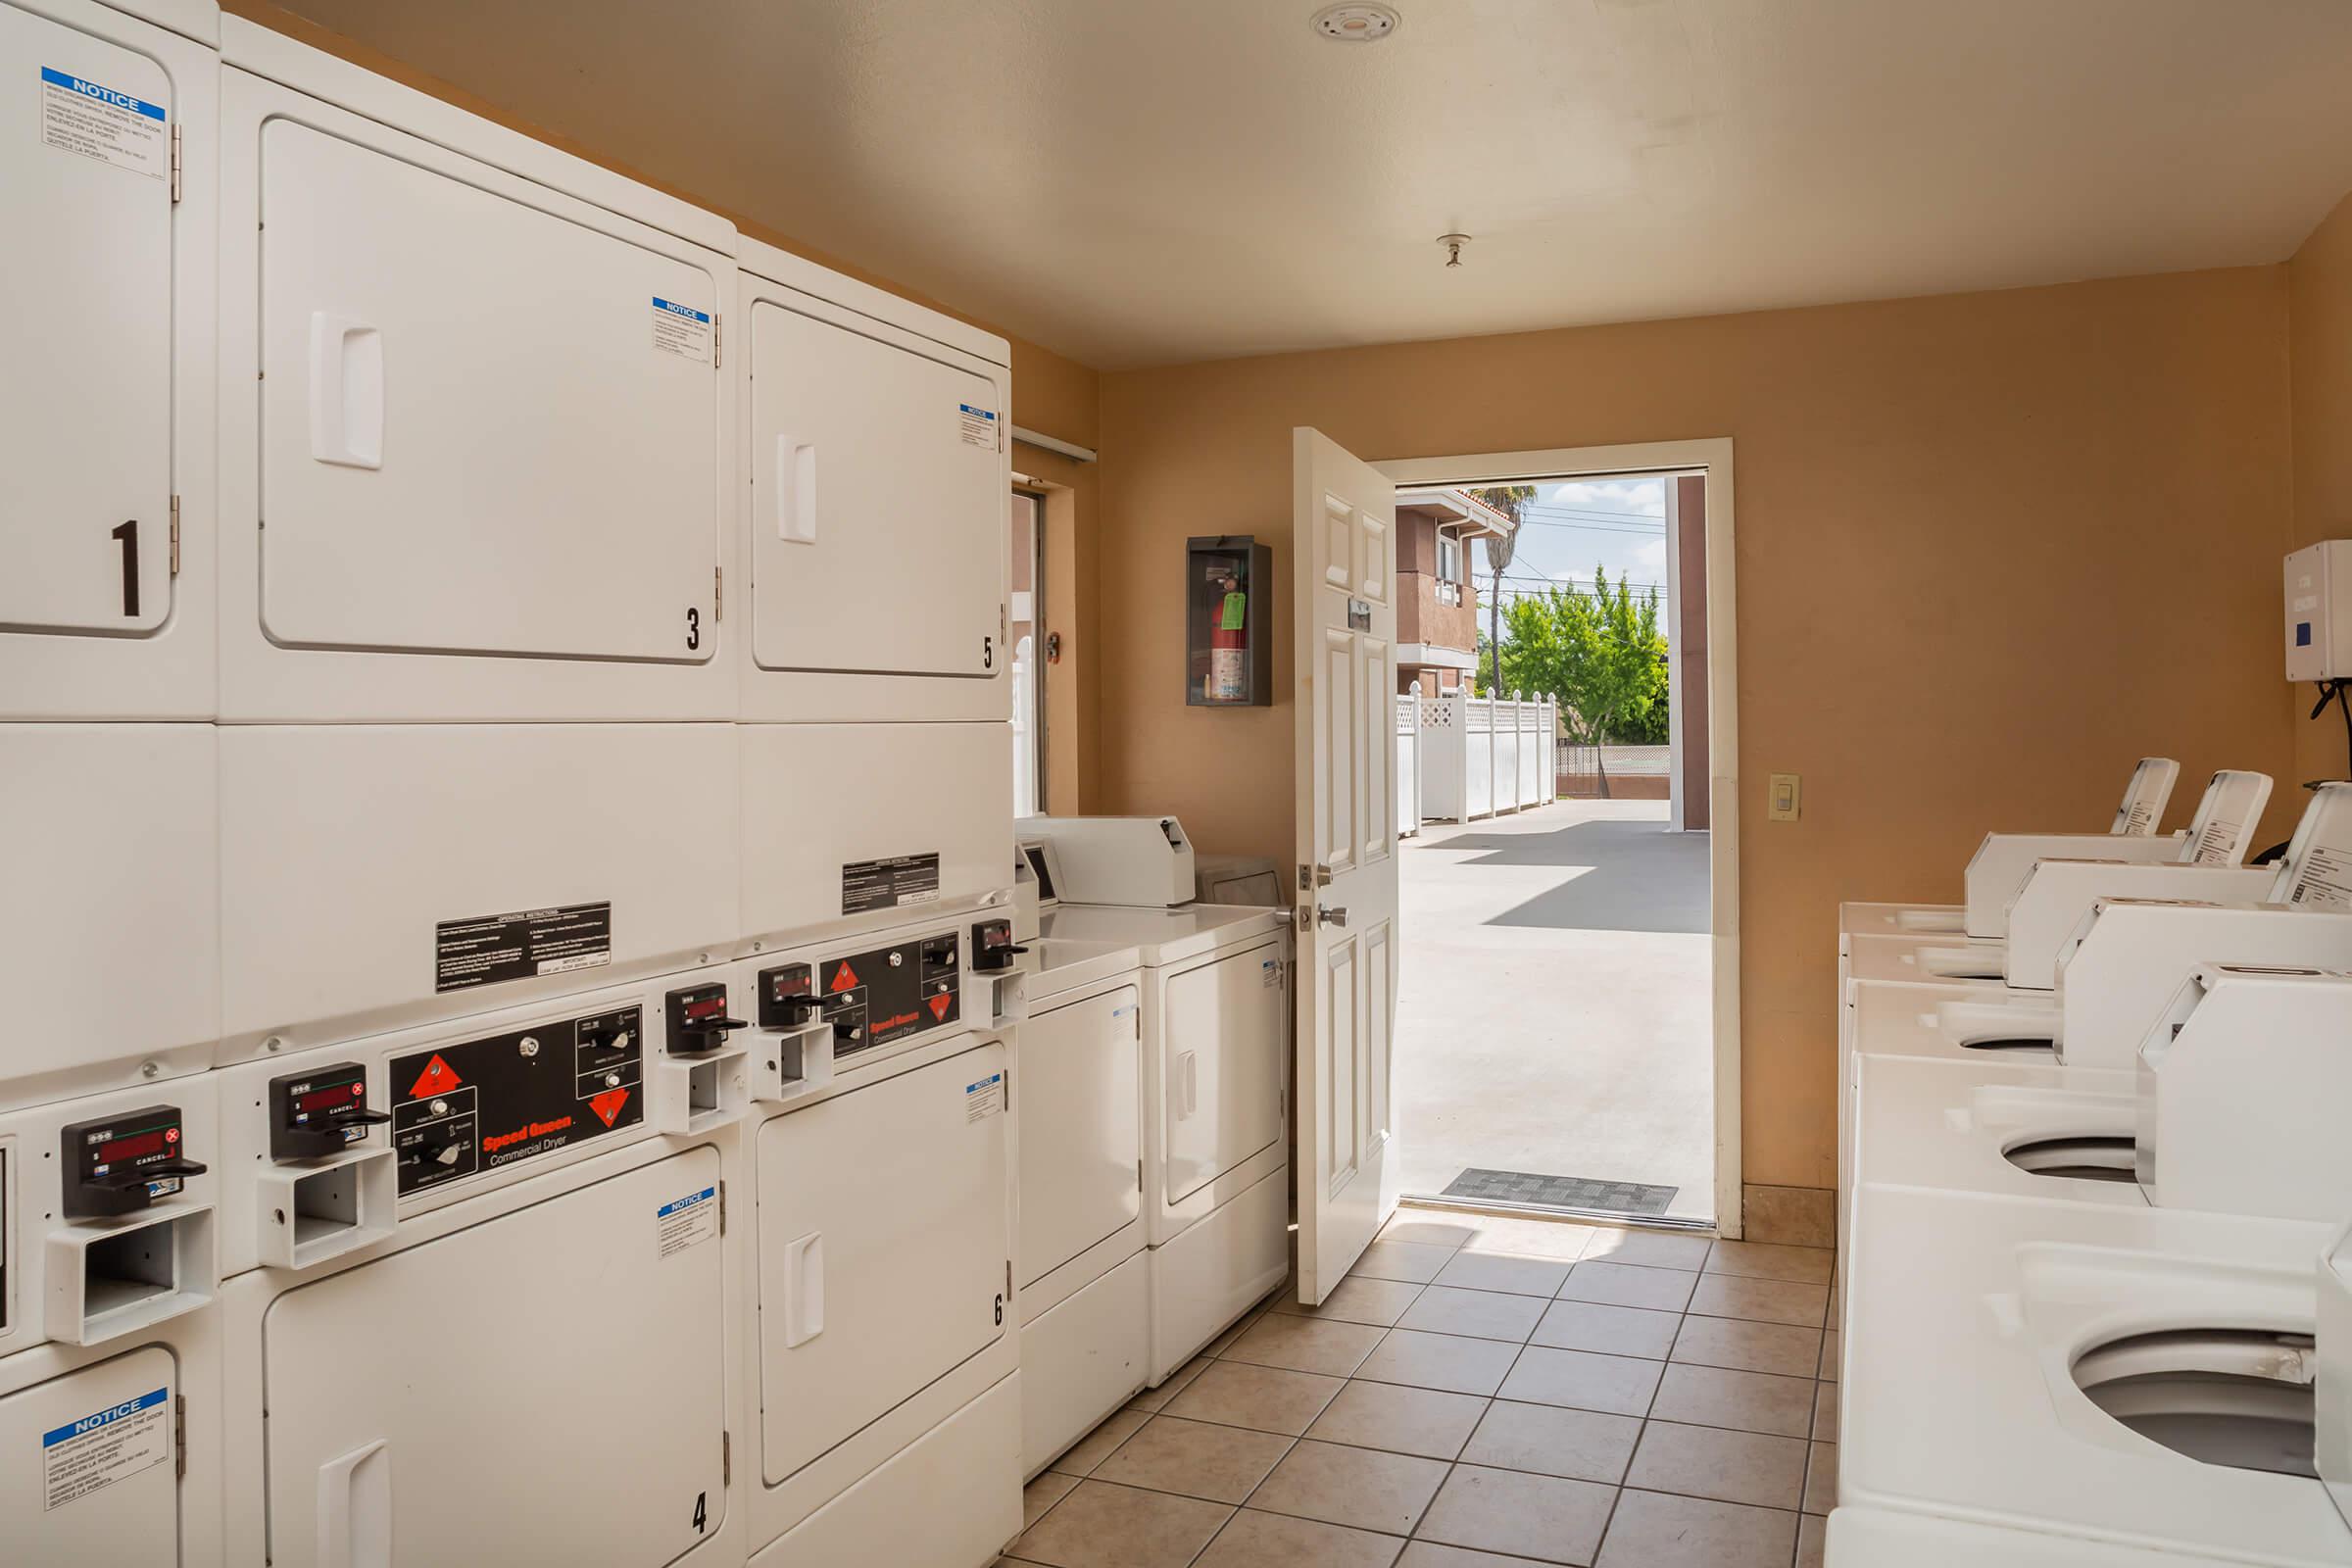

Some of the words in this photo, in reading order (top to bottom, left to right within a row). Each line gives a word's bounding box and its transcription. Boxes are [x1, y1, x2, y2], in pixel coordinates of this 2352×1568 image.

[74, 78, 139, 112] NOTICE
[105, 110, 129, 123] REMOVE
[666, 302, 699, 319] NOTICE
[112, 519, 139, 616] 1
[687, 608, 699, 650] 3
[984, 637, 992, 668] 5
[870, 1016, 894, 1034] Speed
[329, 1104, 353, 1114] CANCEL
[483, 1125, 528, 1152] Speed
[529, 1116, 571, 1137] Queen
[136, 1153, 165, 1165] CANCEL
[490, 1142, 542, 1166] Commercial
[543, 1136, 566, 1151] Dryer
[671, 1192, 703, 1211] NOTICE
[995, 1293, 1002, 1326] 6
[75, 1398, 141, 1434] NOTICE
[107, 1423, 131, 1438] REMOVE
[133, 1417, 144, 1427] THE
[88, 1459, 96, 1468] LA
[77, 1487, 85, 1495] LA
[693, 1491, 706, 1535] 4
